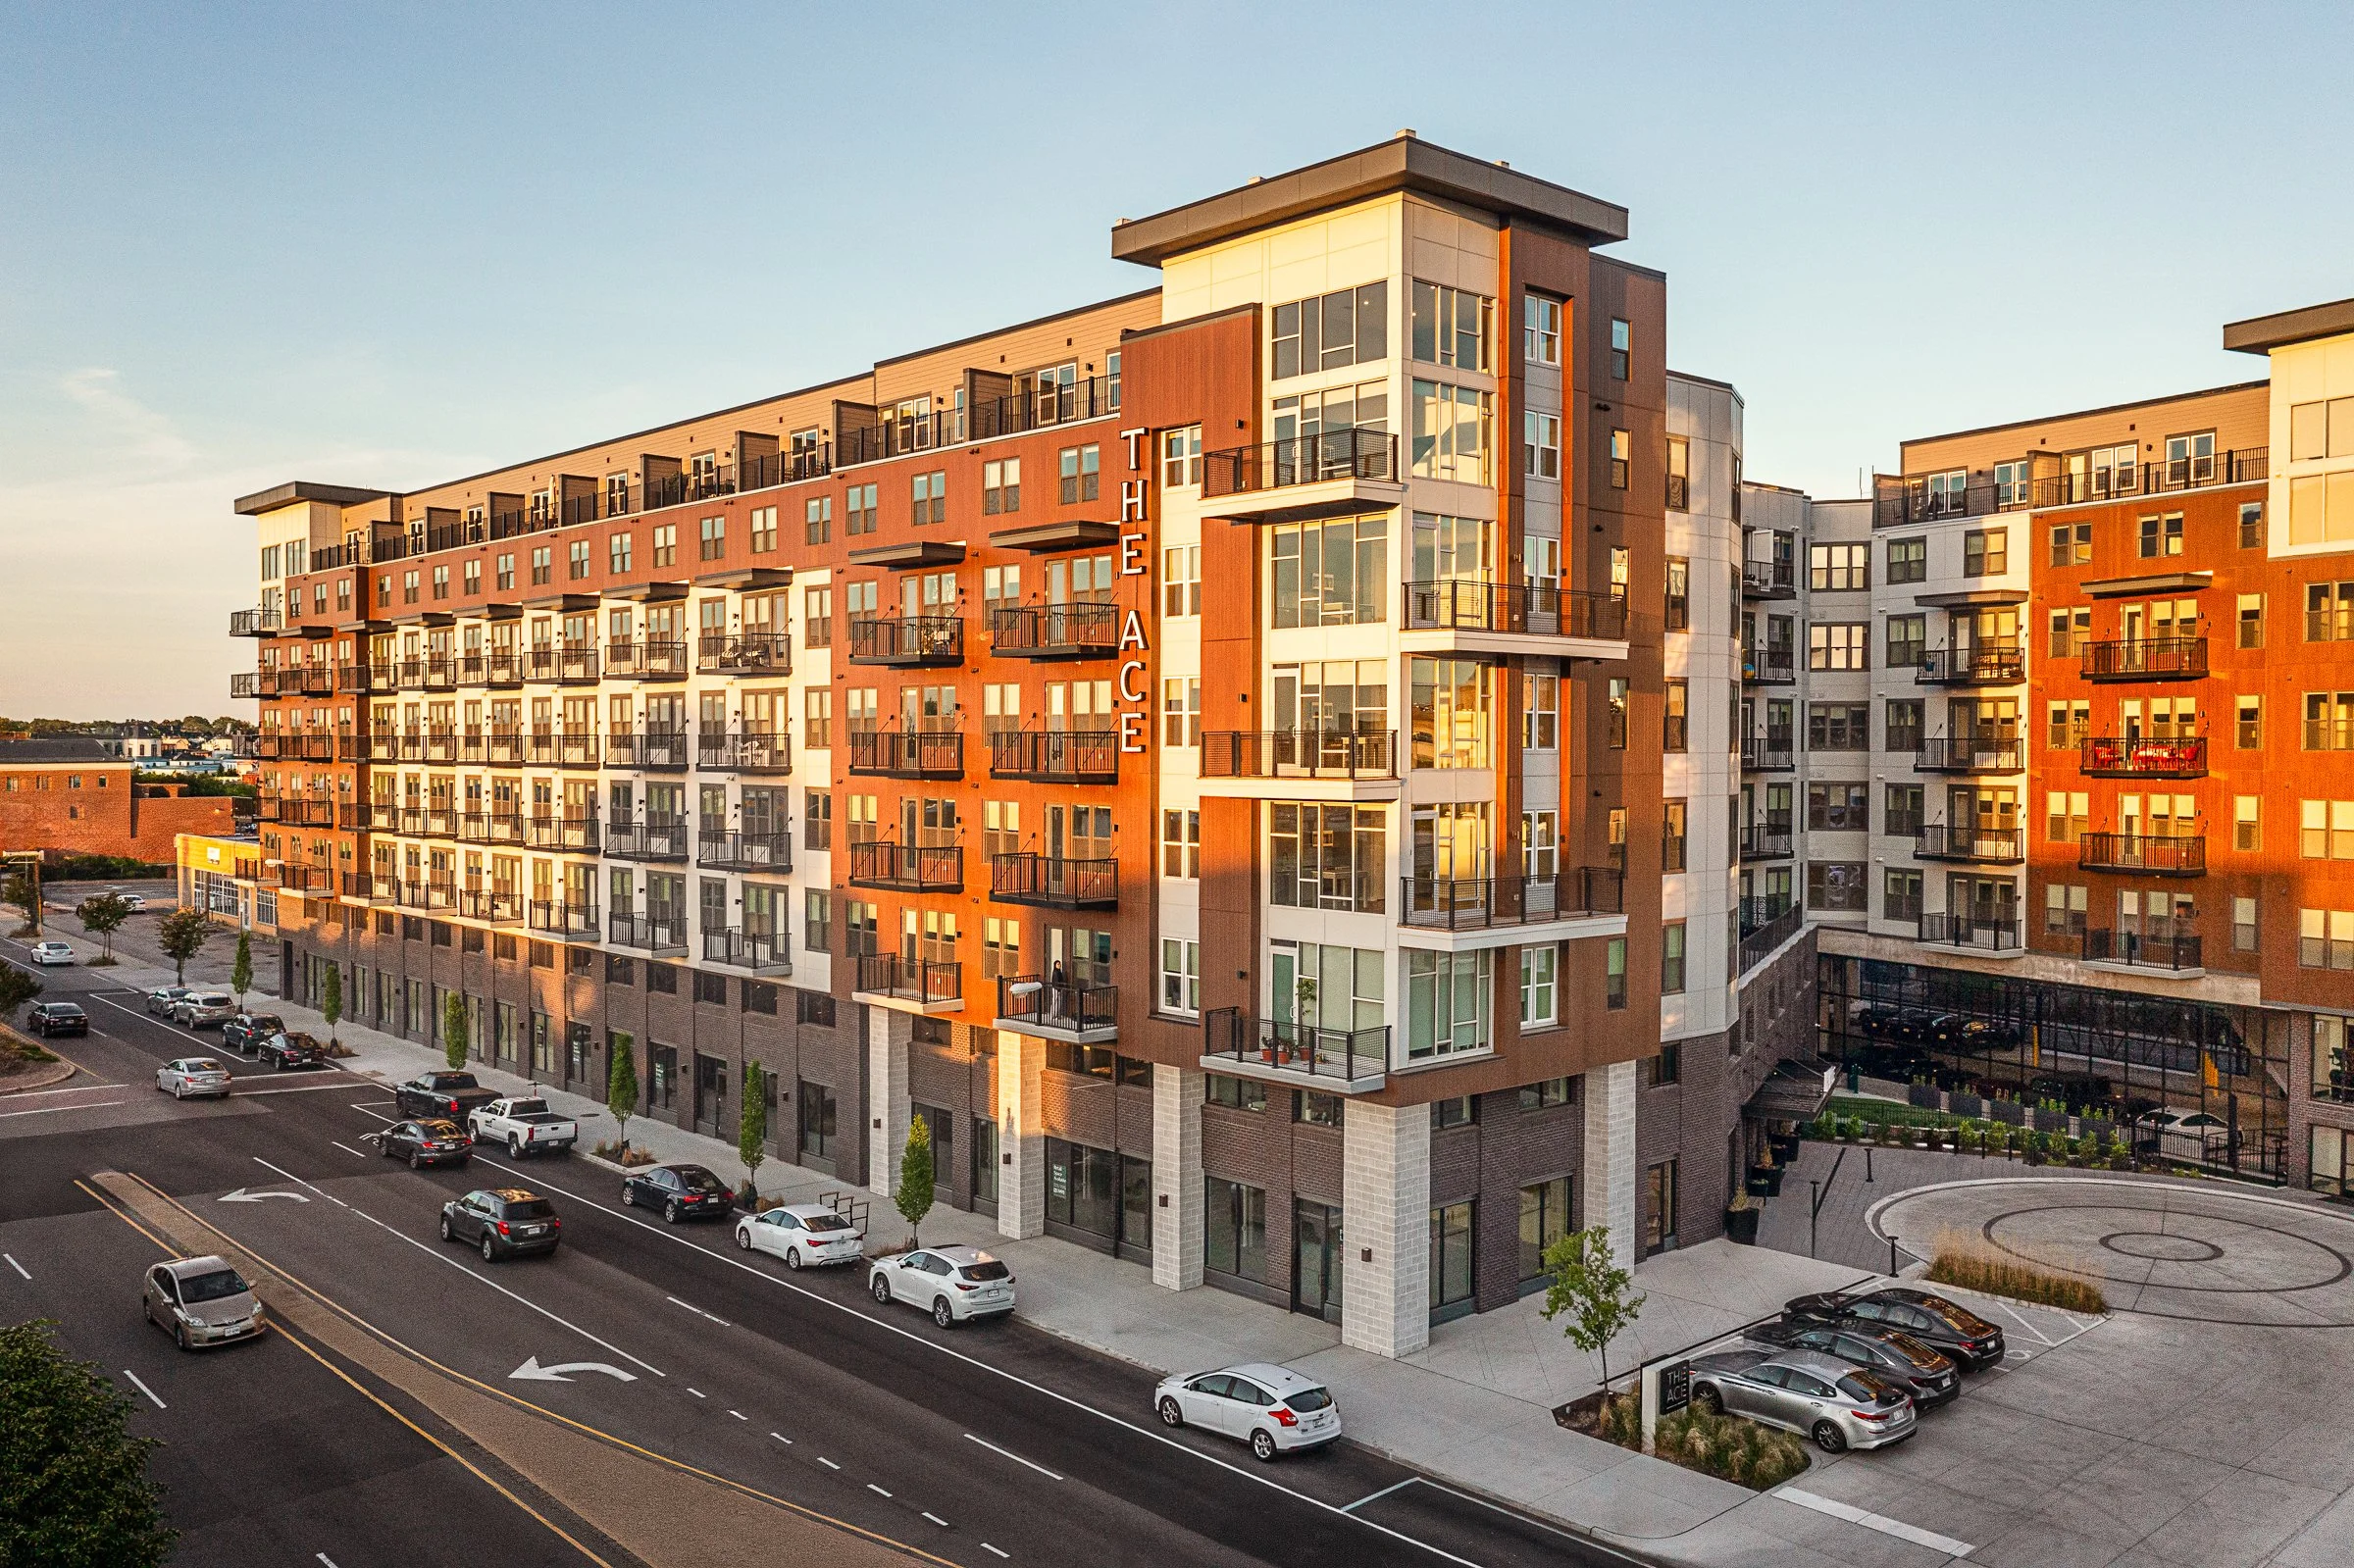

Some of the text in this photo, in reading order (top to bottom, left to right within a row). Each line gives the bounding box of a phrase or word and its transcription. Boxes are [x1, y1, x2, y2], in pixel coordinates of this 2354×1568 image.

[1119, 427, 1150, 753] THE ACE
[1667, 1366, 1687, 1385] THE
[1667, 1383, 1687, 1402] ACE
